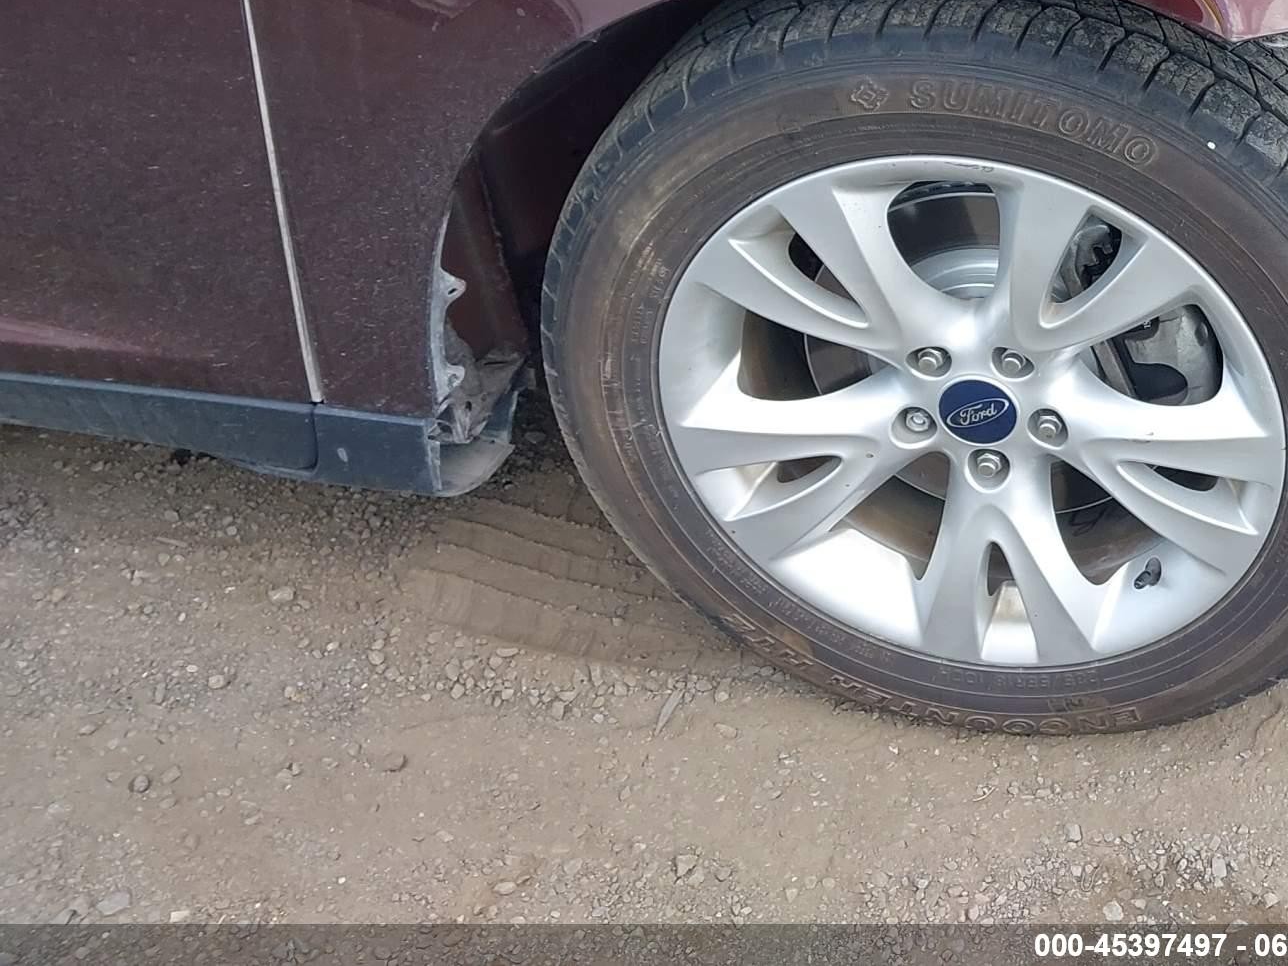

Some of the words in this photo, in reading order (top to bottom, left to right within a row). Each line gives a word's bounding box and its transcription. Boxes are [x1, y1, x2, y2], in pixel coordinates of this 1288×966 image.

[908, 79, 1160, 166] SUMITOMO
[960, 401, 999, 427] Ford
[827, 672, 1143, 733] ENCOUNTER
